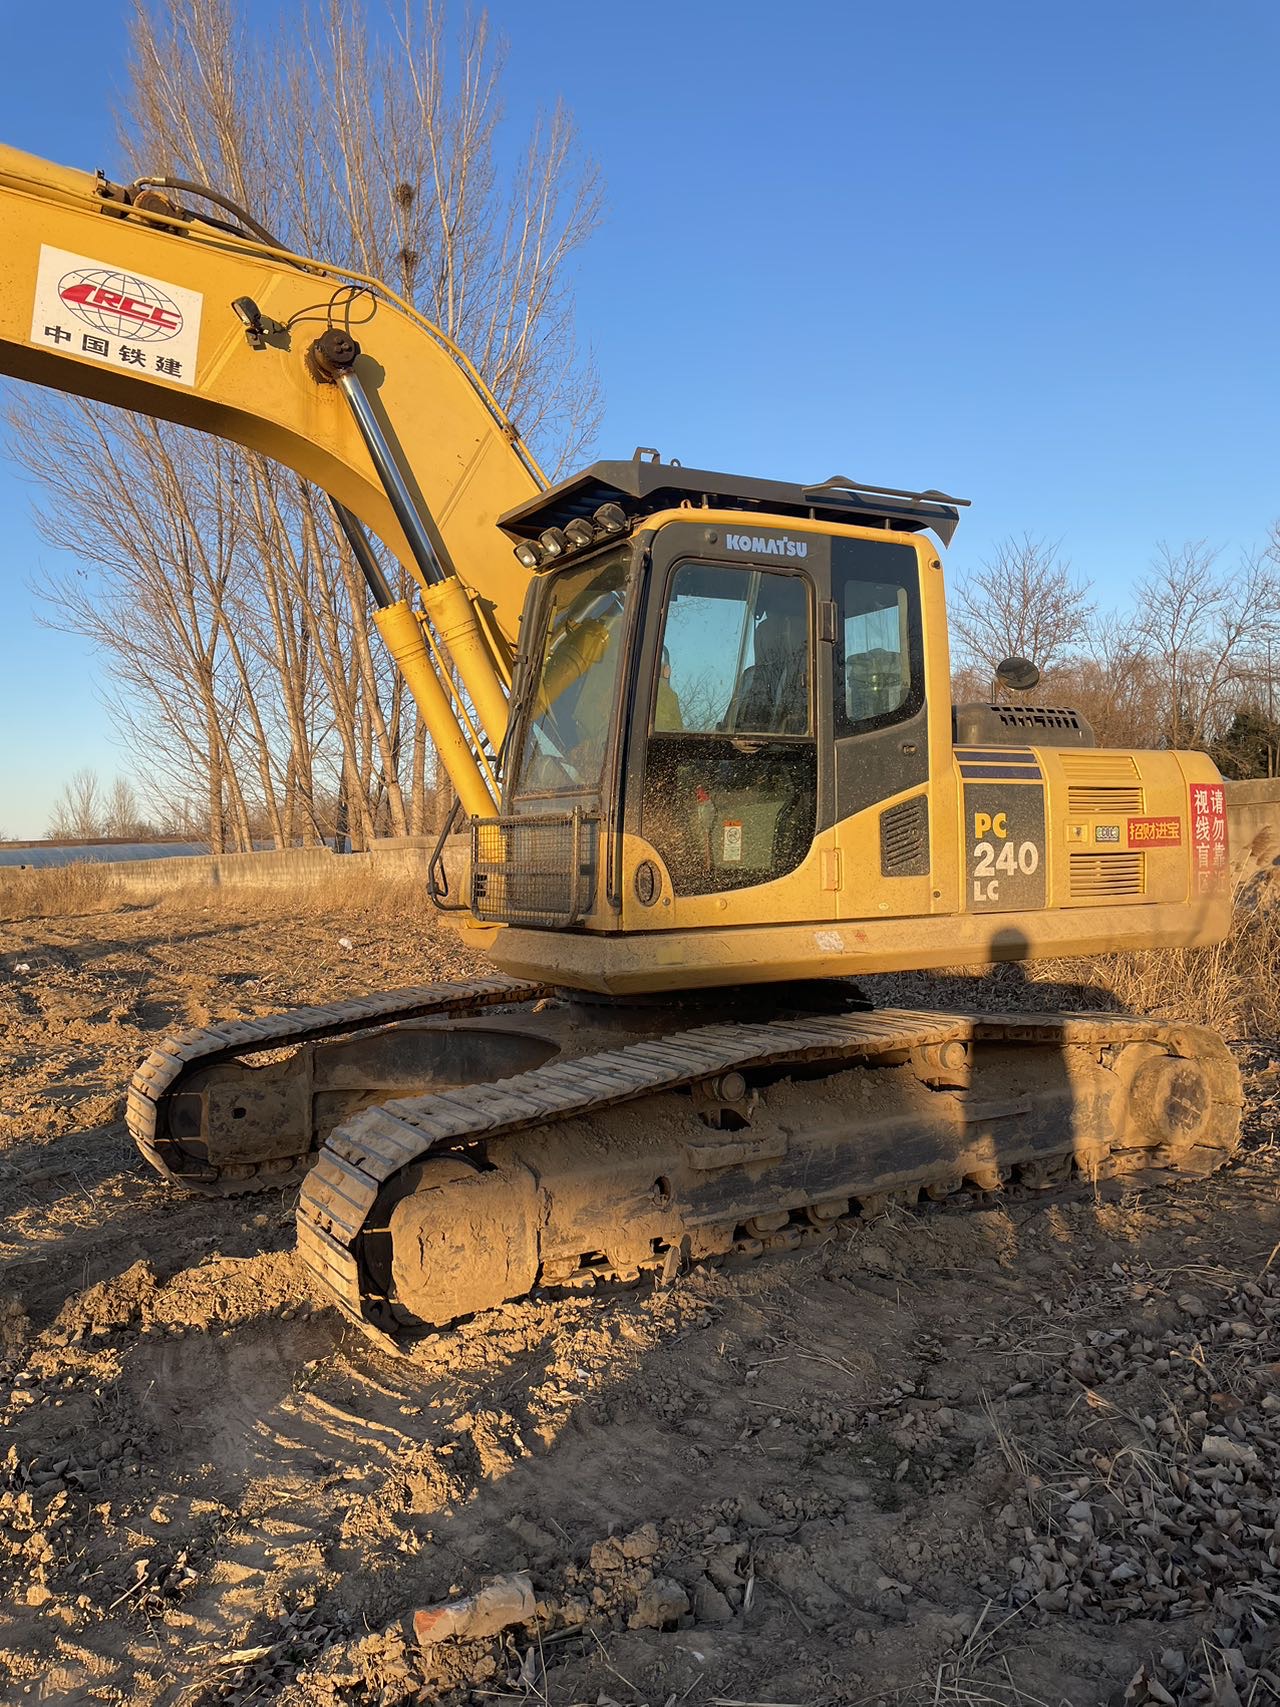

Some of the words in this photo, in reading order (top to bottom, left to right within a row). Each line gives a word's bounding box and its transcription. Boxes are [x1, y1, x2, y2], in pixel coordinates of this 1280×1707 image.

[44, 325, 182, 378] 中国铁建
[726, 534, 807, 558] KOMATSU
[974, 812, 1008, 839] PC
[1129, 821, 1180, 841] 招财进宝
[973, 841, 1039, 877] 240
[973, 880, 999, 902] LC
